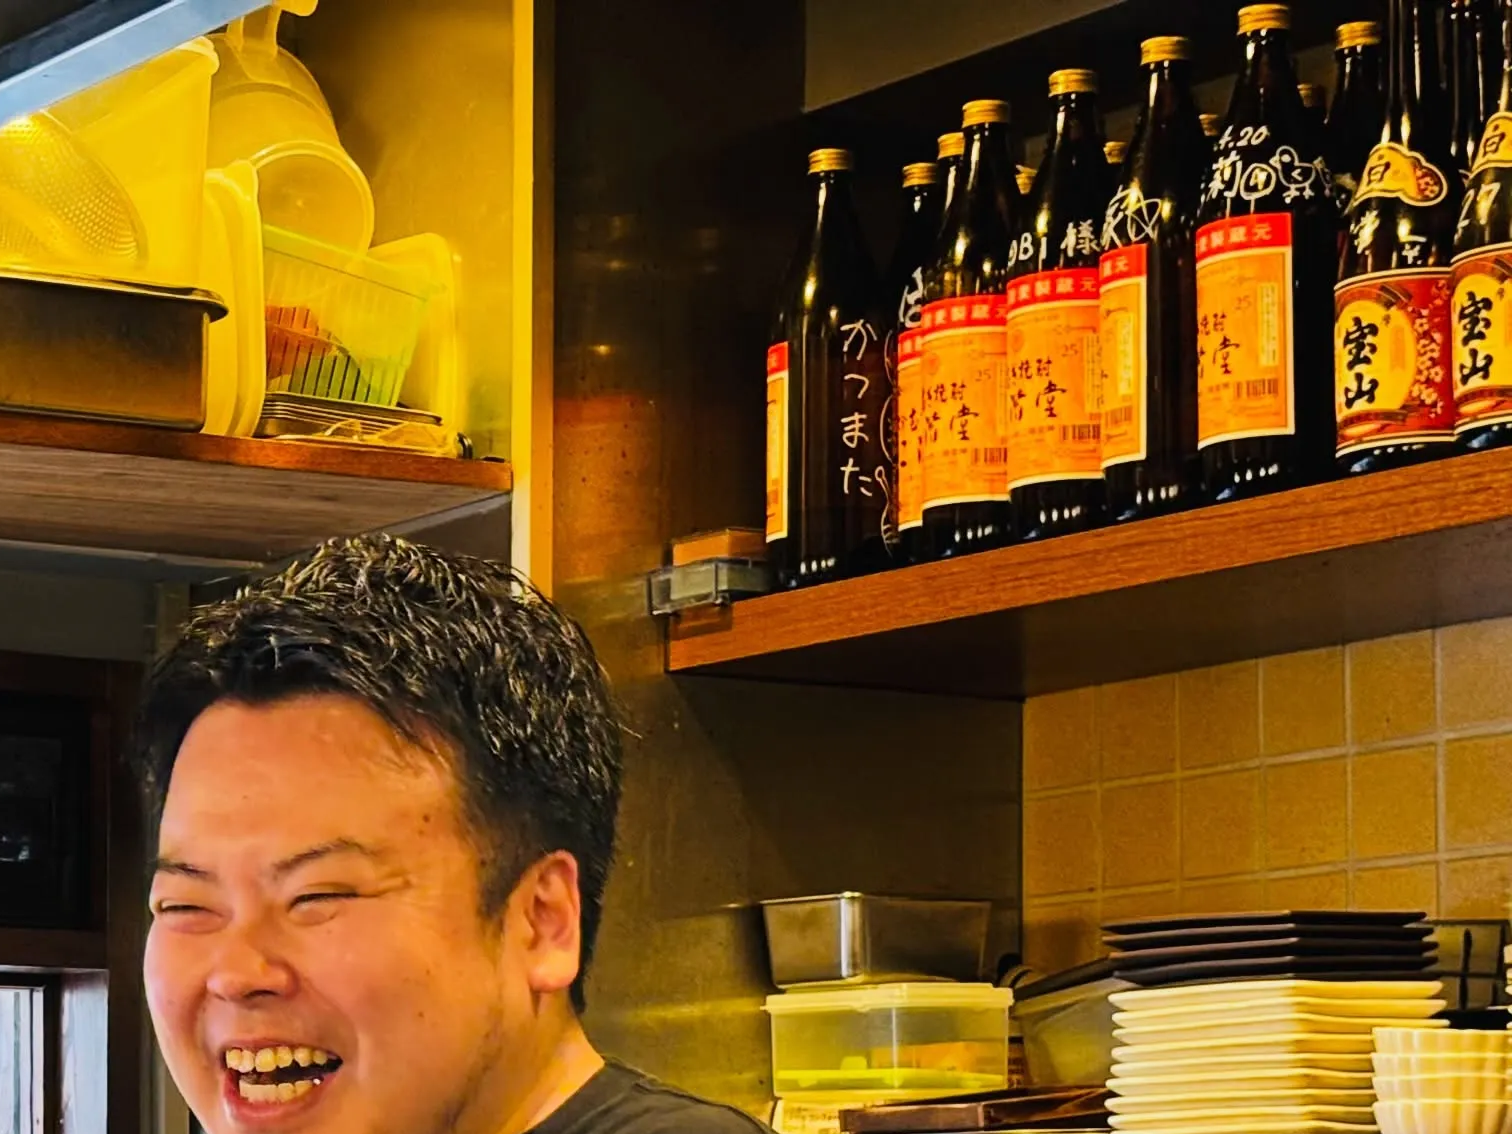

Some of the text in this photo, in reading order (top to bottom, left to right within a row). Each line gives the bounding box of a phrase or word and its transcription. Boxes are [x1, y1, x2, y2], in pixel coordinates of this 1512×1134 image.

[1343, 316, 1379, 410] 宝山
[1458, 291, 1493, 385] 宝山
[840, 319, 877, 496] かつまた
